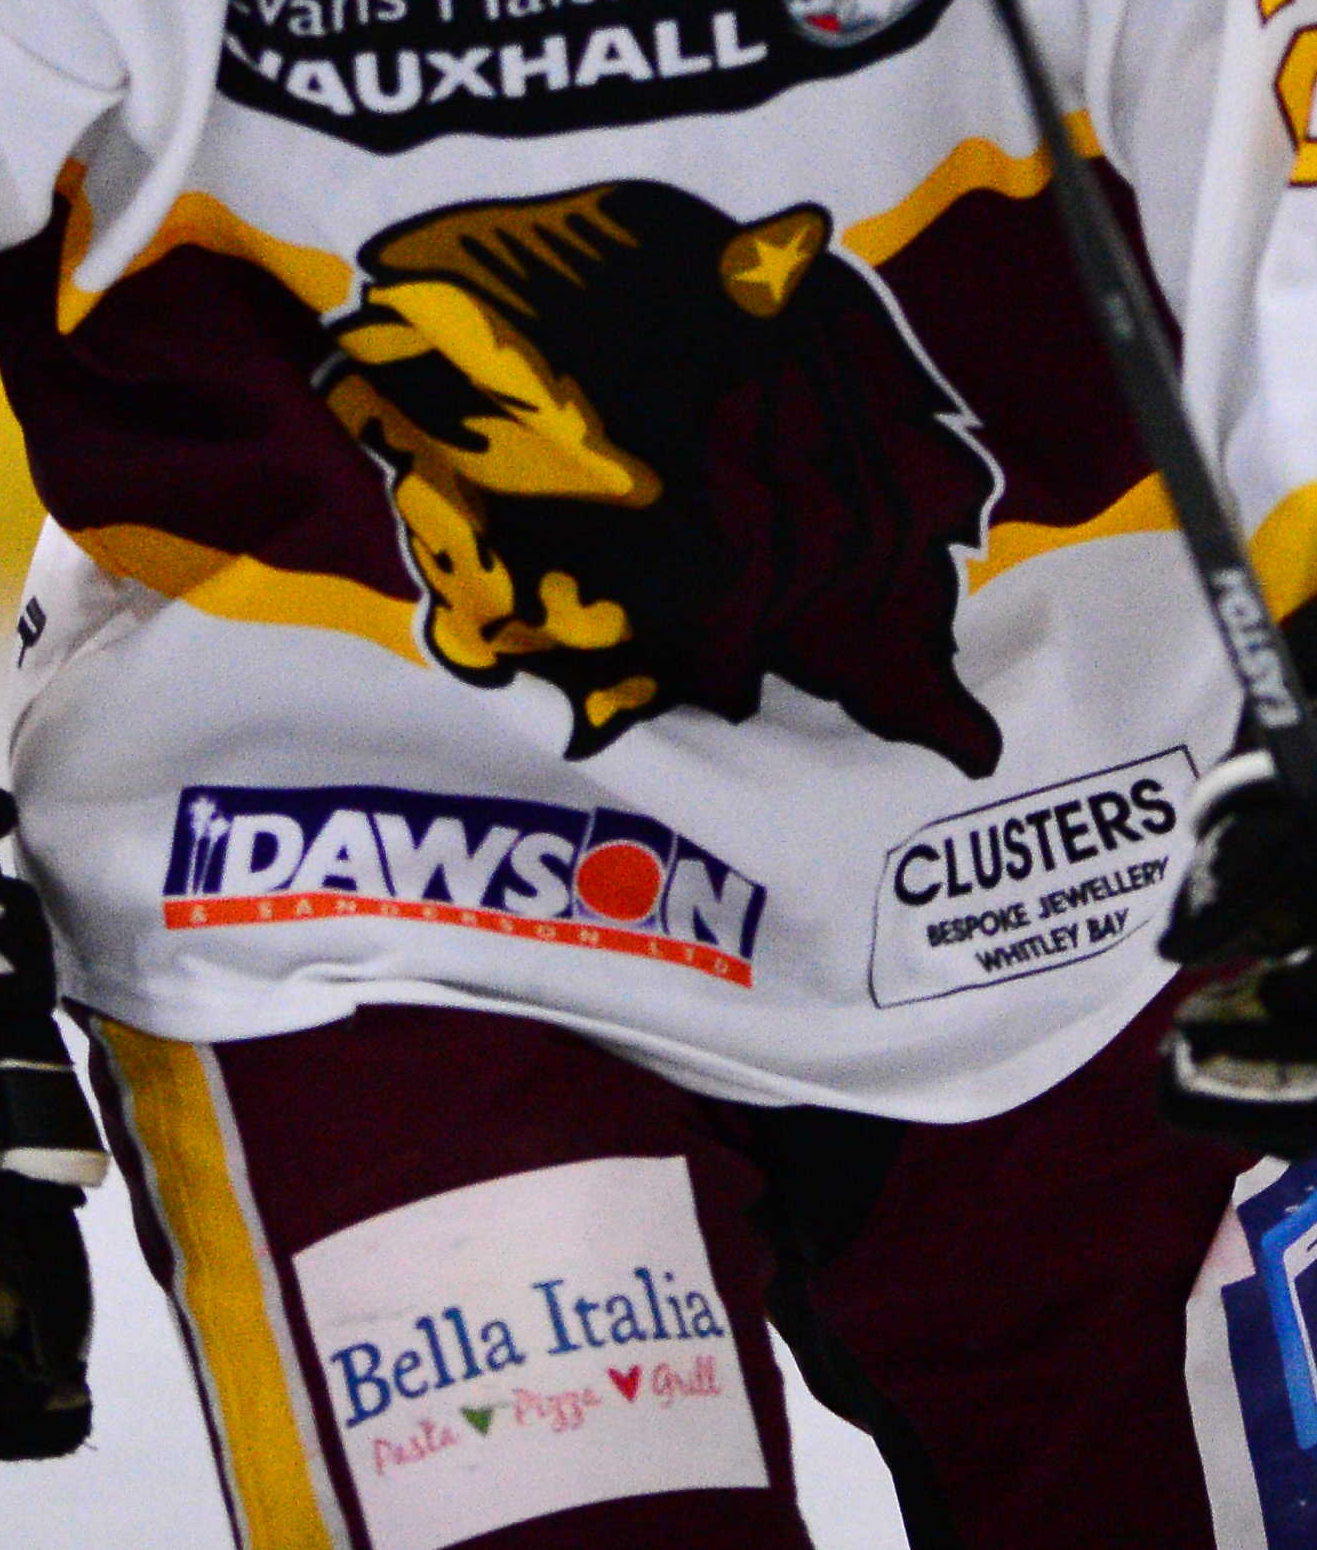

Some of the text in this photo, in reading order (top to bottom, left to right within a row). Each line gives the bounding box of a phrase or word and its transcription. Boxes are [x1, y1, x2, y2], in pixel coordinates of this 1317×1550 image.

[218, 808, 756, 957] DAWSON
[893, 777, 1177, 907] CLUSTERS
[926, 855, 1170, 948] BESPOKE JEWELLERY
[975, 907, 1131, 974] WHITLEY BAY
[329, 1266, 726, 1429] Bella Italia
